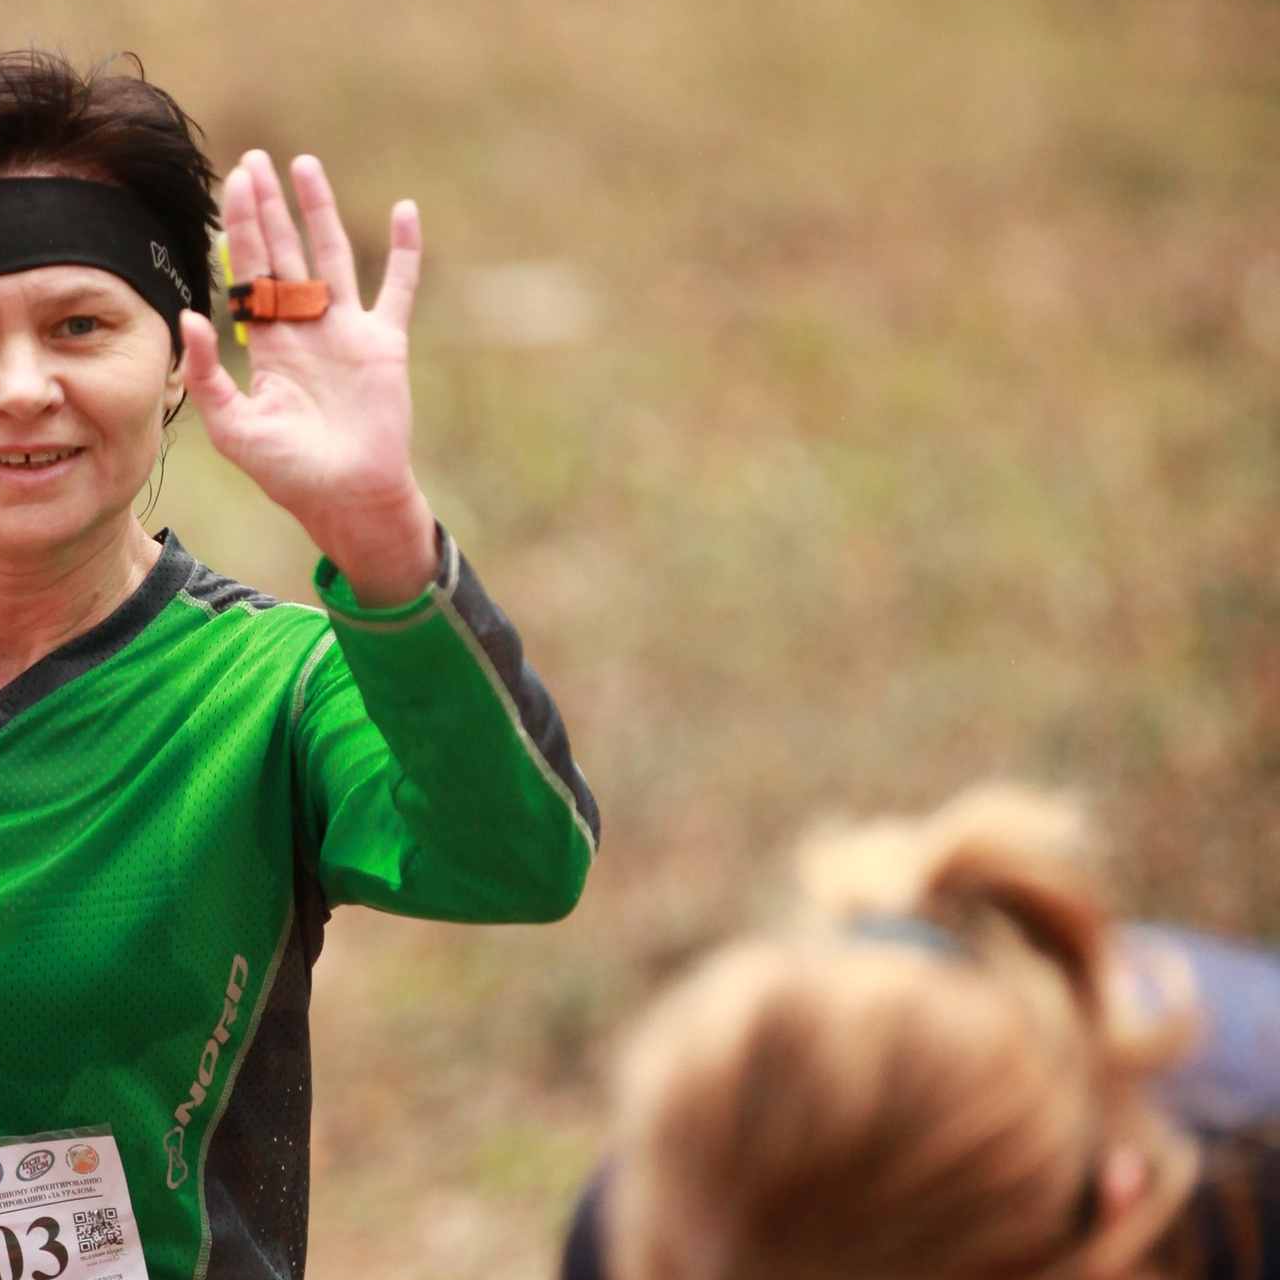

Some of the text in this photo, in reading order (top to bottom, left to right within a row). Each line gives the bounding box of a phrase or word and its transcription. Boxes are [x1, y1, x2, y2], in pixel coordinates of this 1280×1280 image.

[170, 267, 192, 309] NO
[174, 953, 248, 1127] NORD
[30, 1177, 102, 1193] ОРИЕНТИРОВАНИЮ
